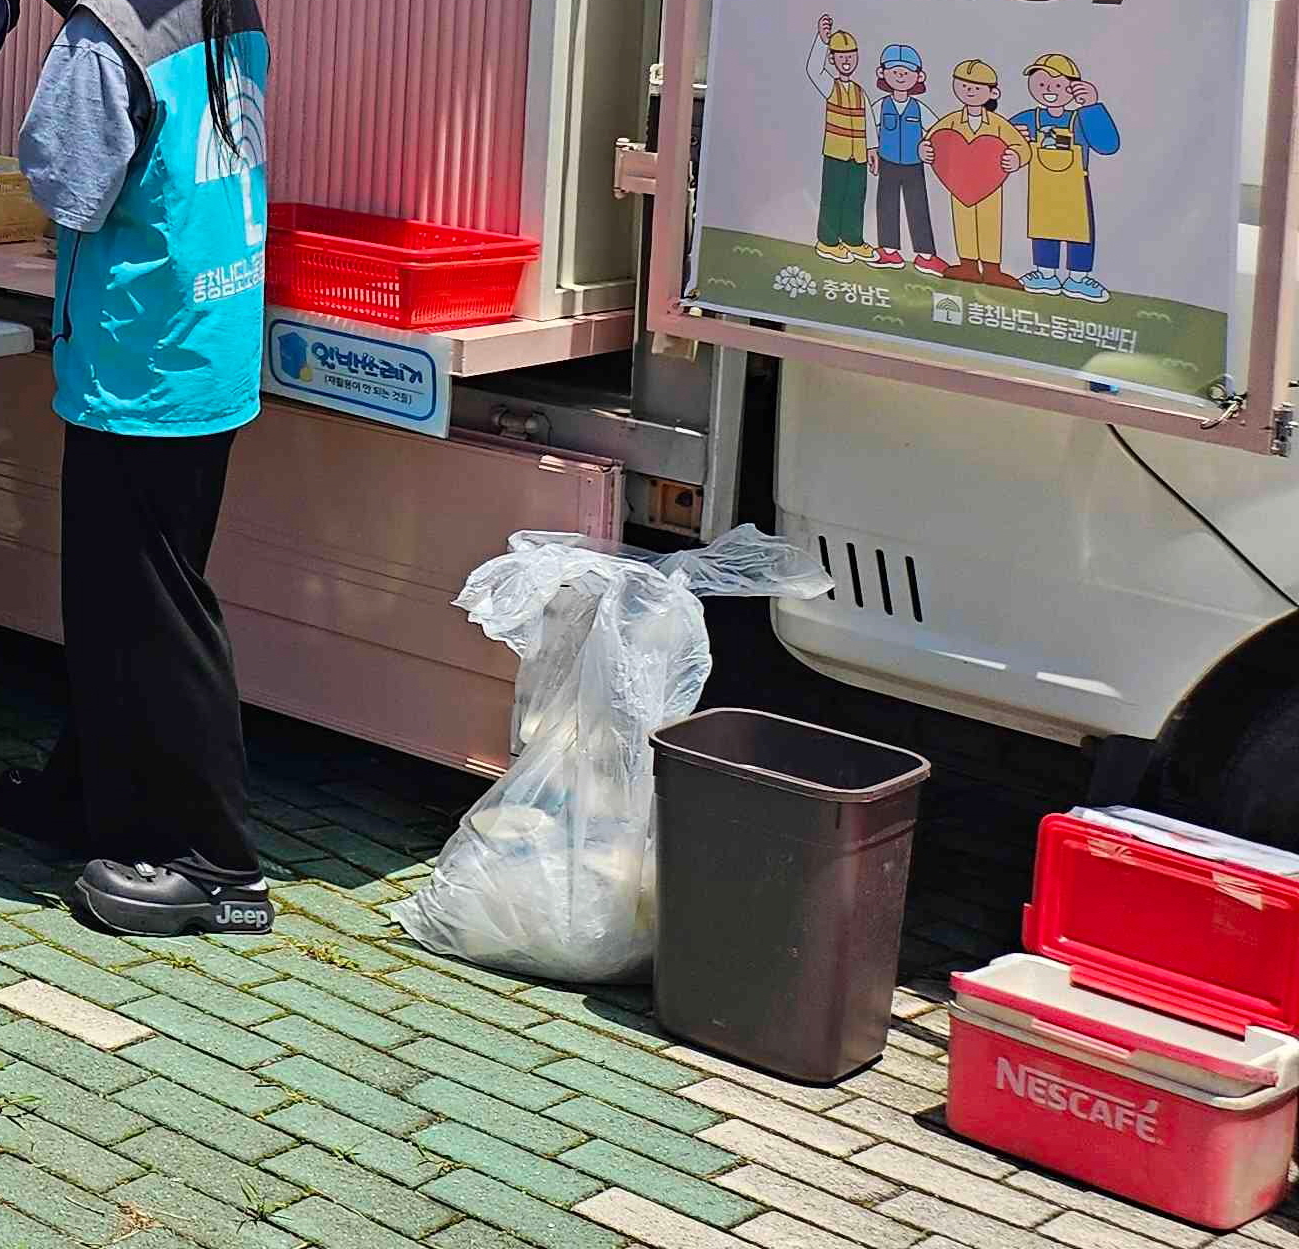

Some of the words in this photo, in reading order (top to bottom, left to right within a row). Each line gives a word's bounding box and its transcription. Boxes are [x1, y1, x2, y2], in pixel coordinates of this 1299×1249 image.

[822, 278, 893, 309] 충청남도
[966, 302, 1138, 354] 충청남도노동권익센터
[310, 341, 423, 384] 일반쓰레기
[215, 904, 269, 928] Jeep
